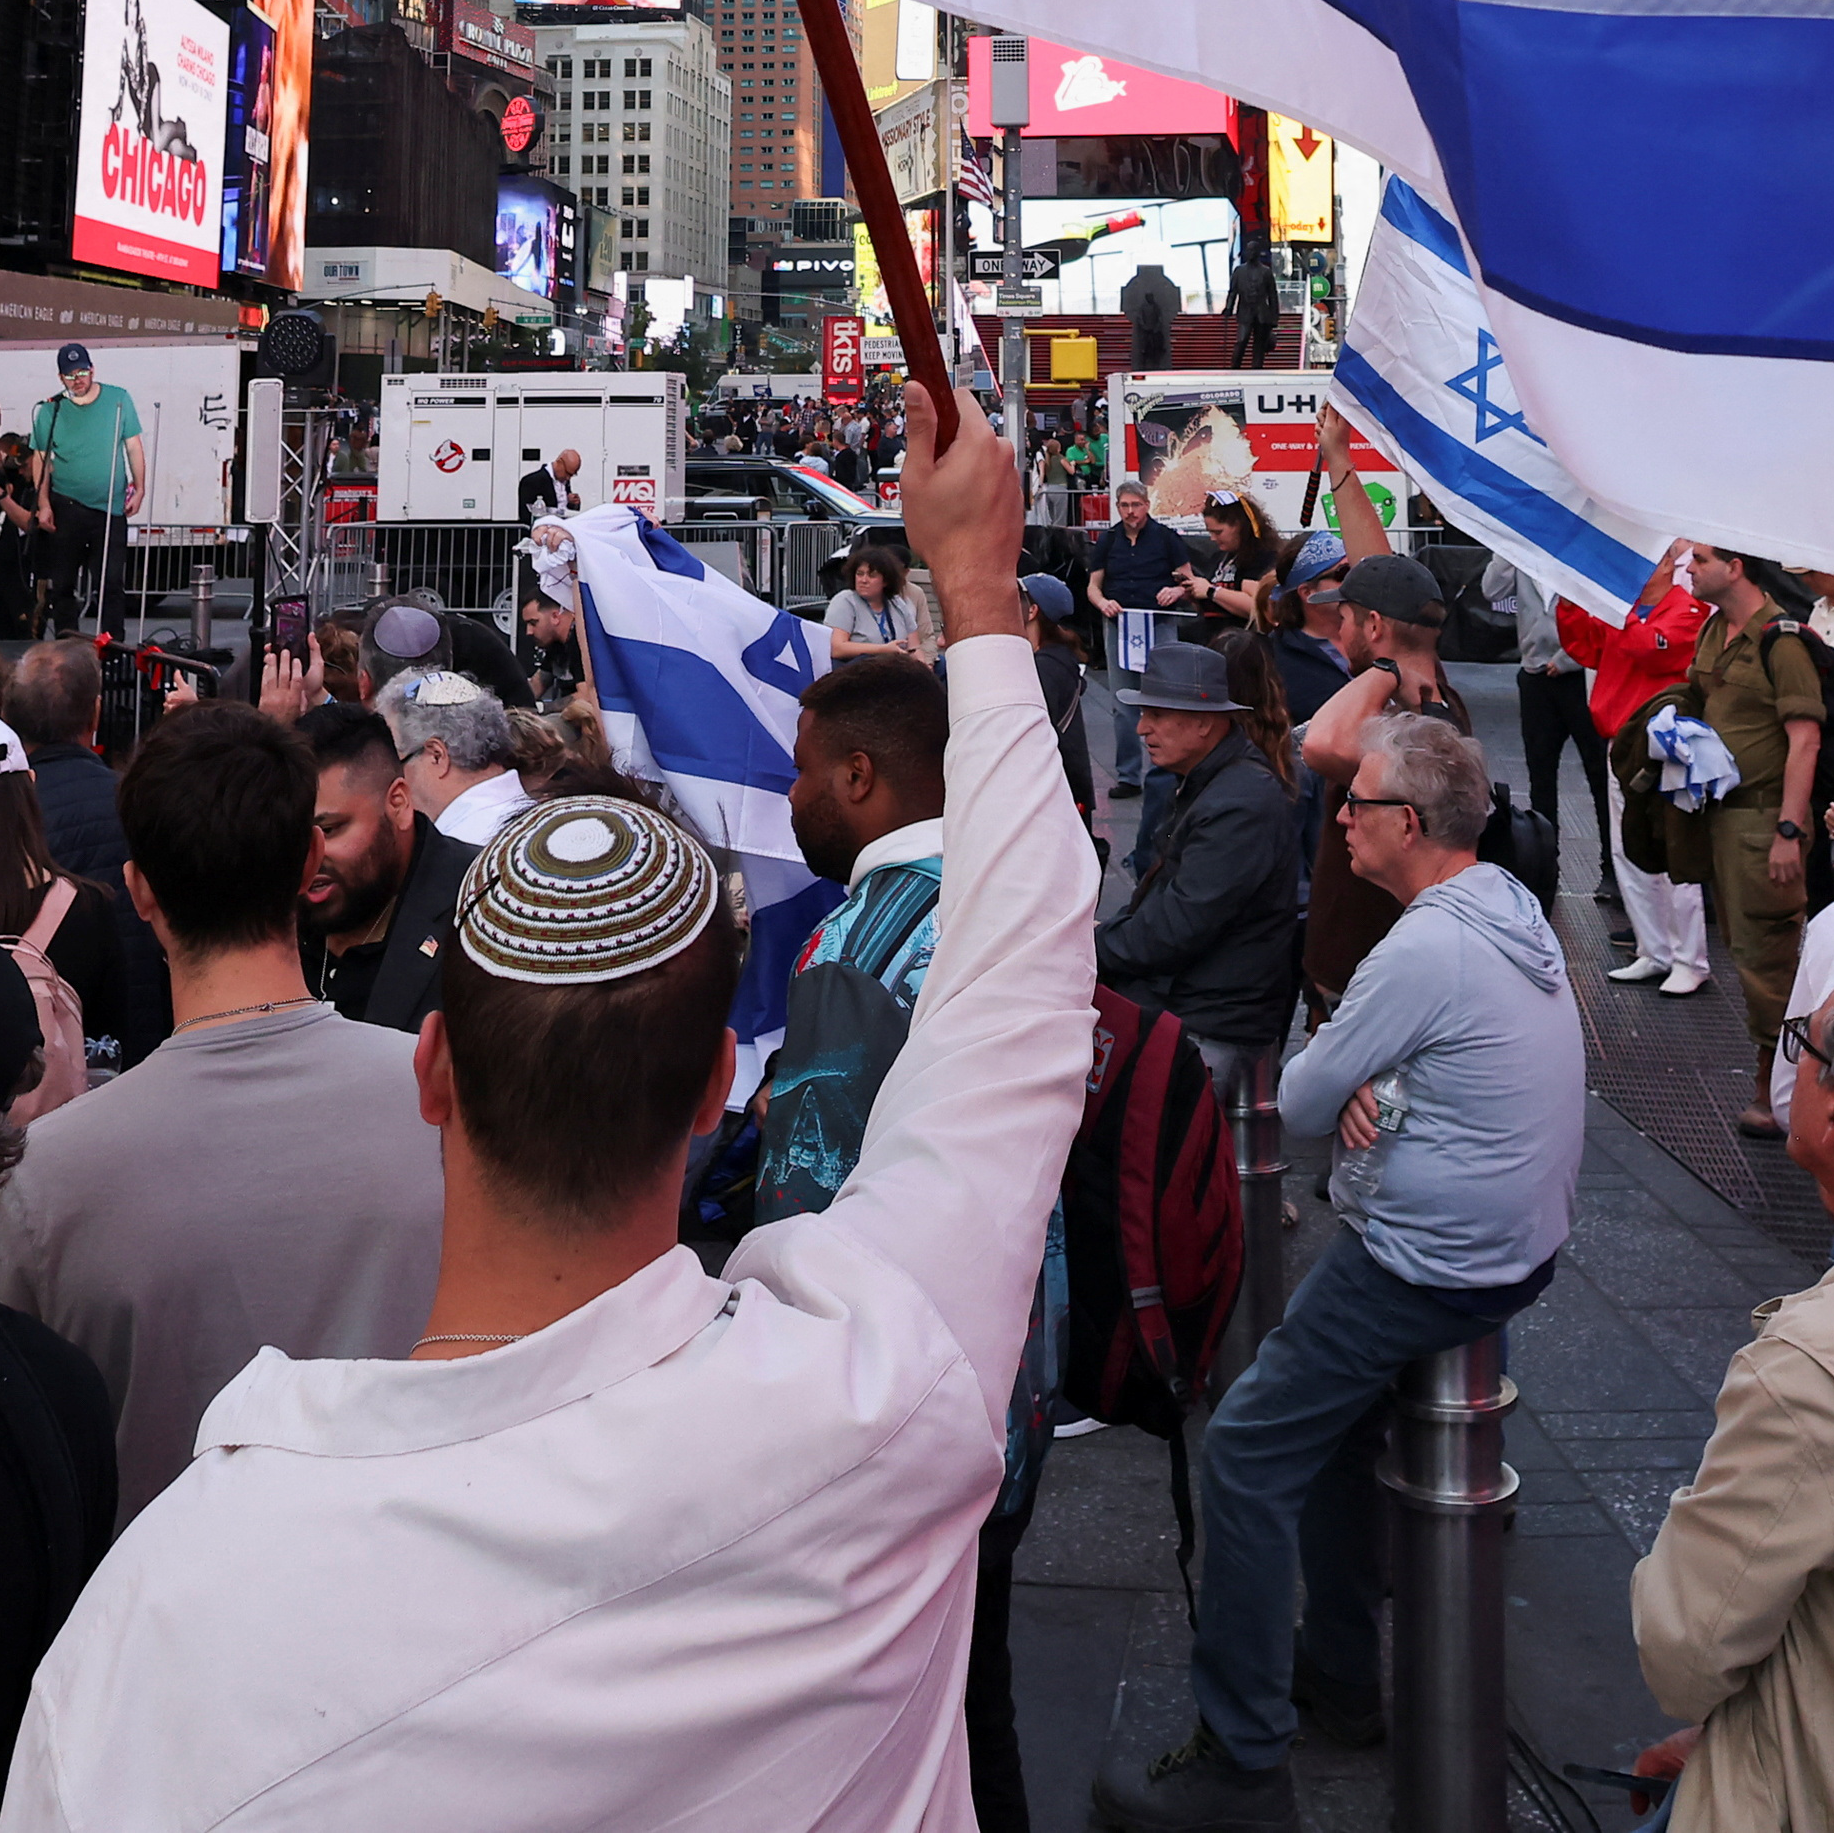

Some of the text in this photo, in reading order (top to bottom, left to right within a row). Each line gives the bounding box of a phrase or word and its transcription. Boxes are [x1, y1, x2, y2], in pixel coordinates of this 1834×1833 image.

[102, 122, 206, 228] CHICAGO
[0, 302, 54, 322] AMERICAN EAGLE
[79, 311, 124, 328] AMERICAN EAGLE
[832, 320, 860, 374] tkts
[864, 340, 902, 349] PEDESTRIA
[864, 350, 906, 360] KEEP MOVIN
[429, 397, 455, 405] POWER
[1200, 390, 1241, 400] COLORADO
[1258, 393, 1316, 414] U-H
[1271, 442, 1305, 451] ONE-WAY
[1350, 442, 1376, 451] RENTA
[614, 480, 656, 503] MQ
